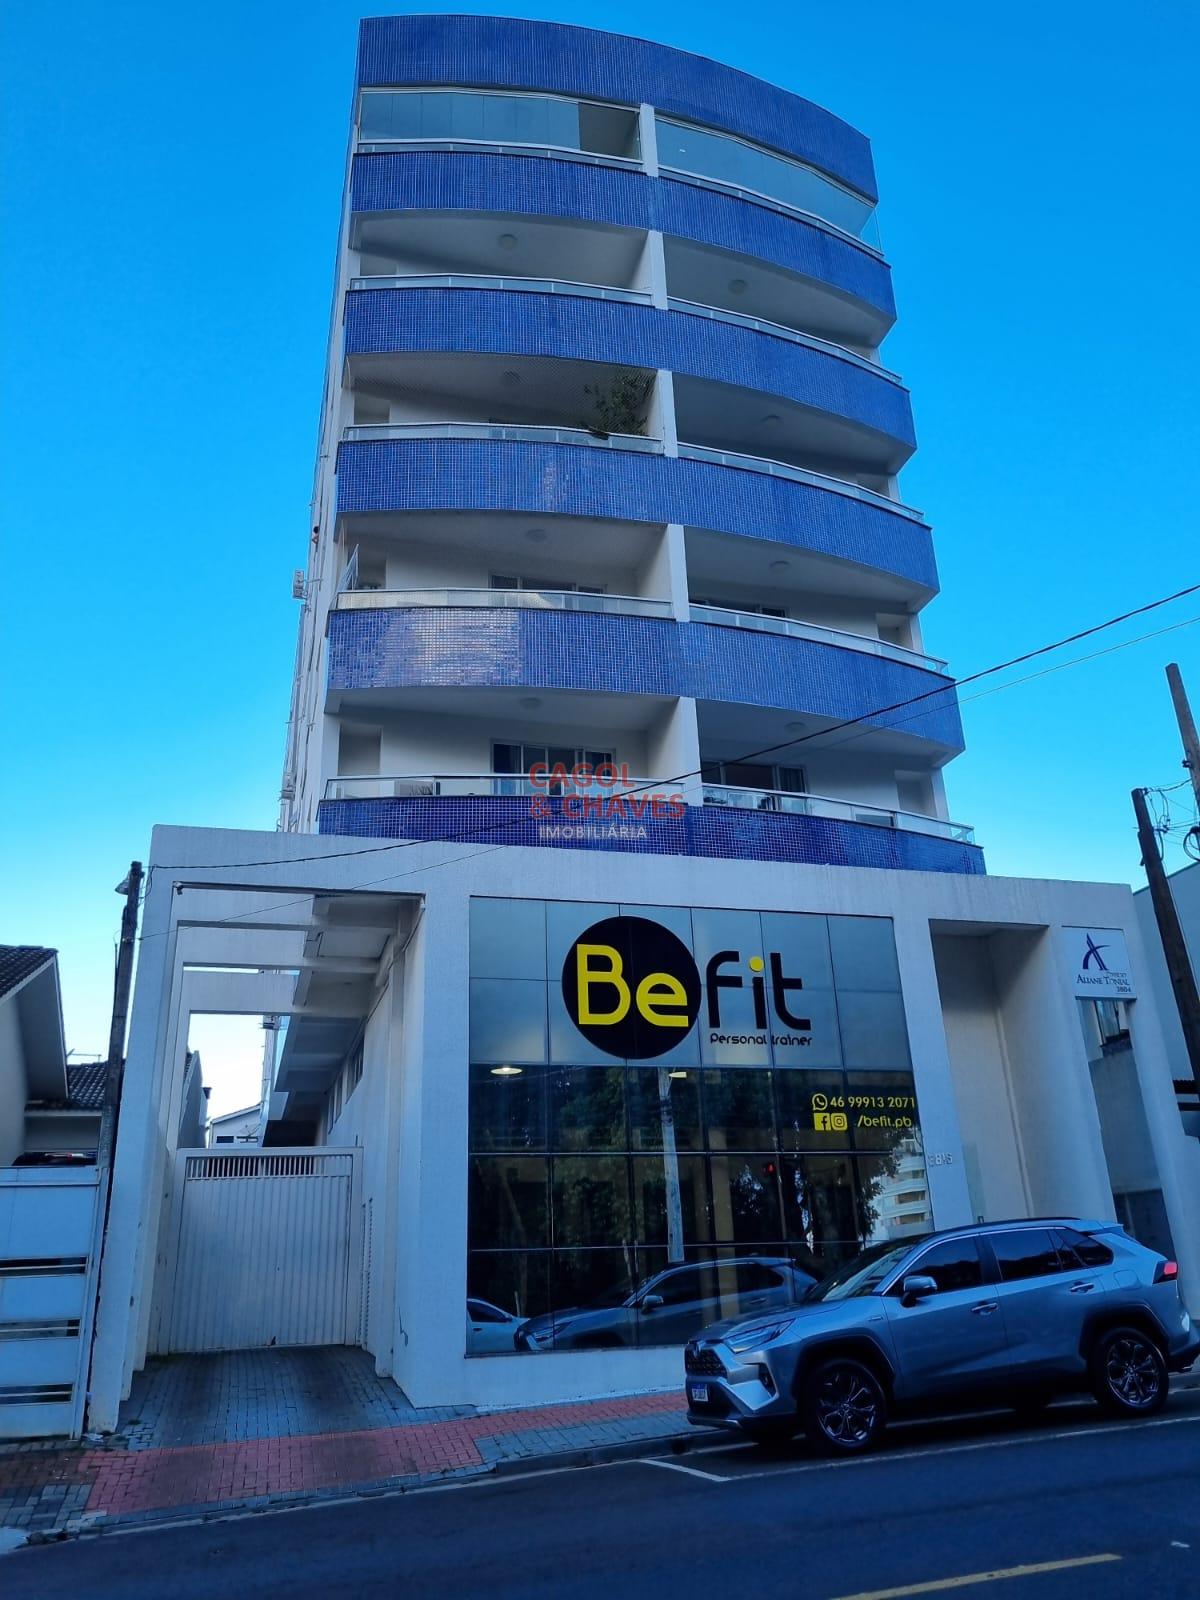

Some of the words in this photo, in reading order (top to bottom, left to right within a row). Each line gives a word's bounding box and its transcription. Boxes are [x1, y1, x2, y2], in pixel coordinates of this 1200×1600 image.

[710, 1032, 768, 1045] Personal
[771, 1033, 812, 1046] trainer
[830, 1096, 845, 1107] 46
[848, 1096, 885, 1108] 99913
[887, 1097, 915, 1108] 2071
